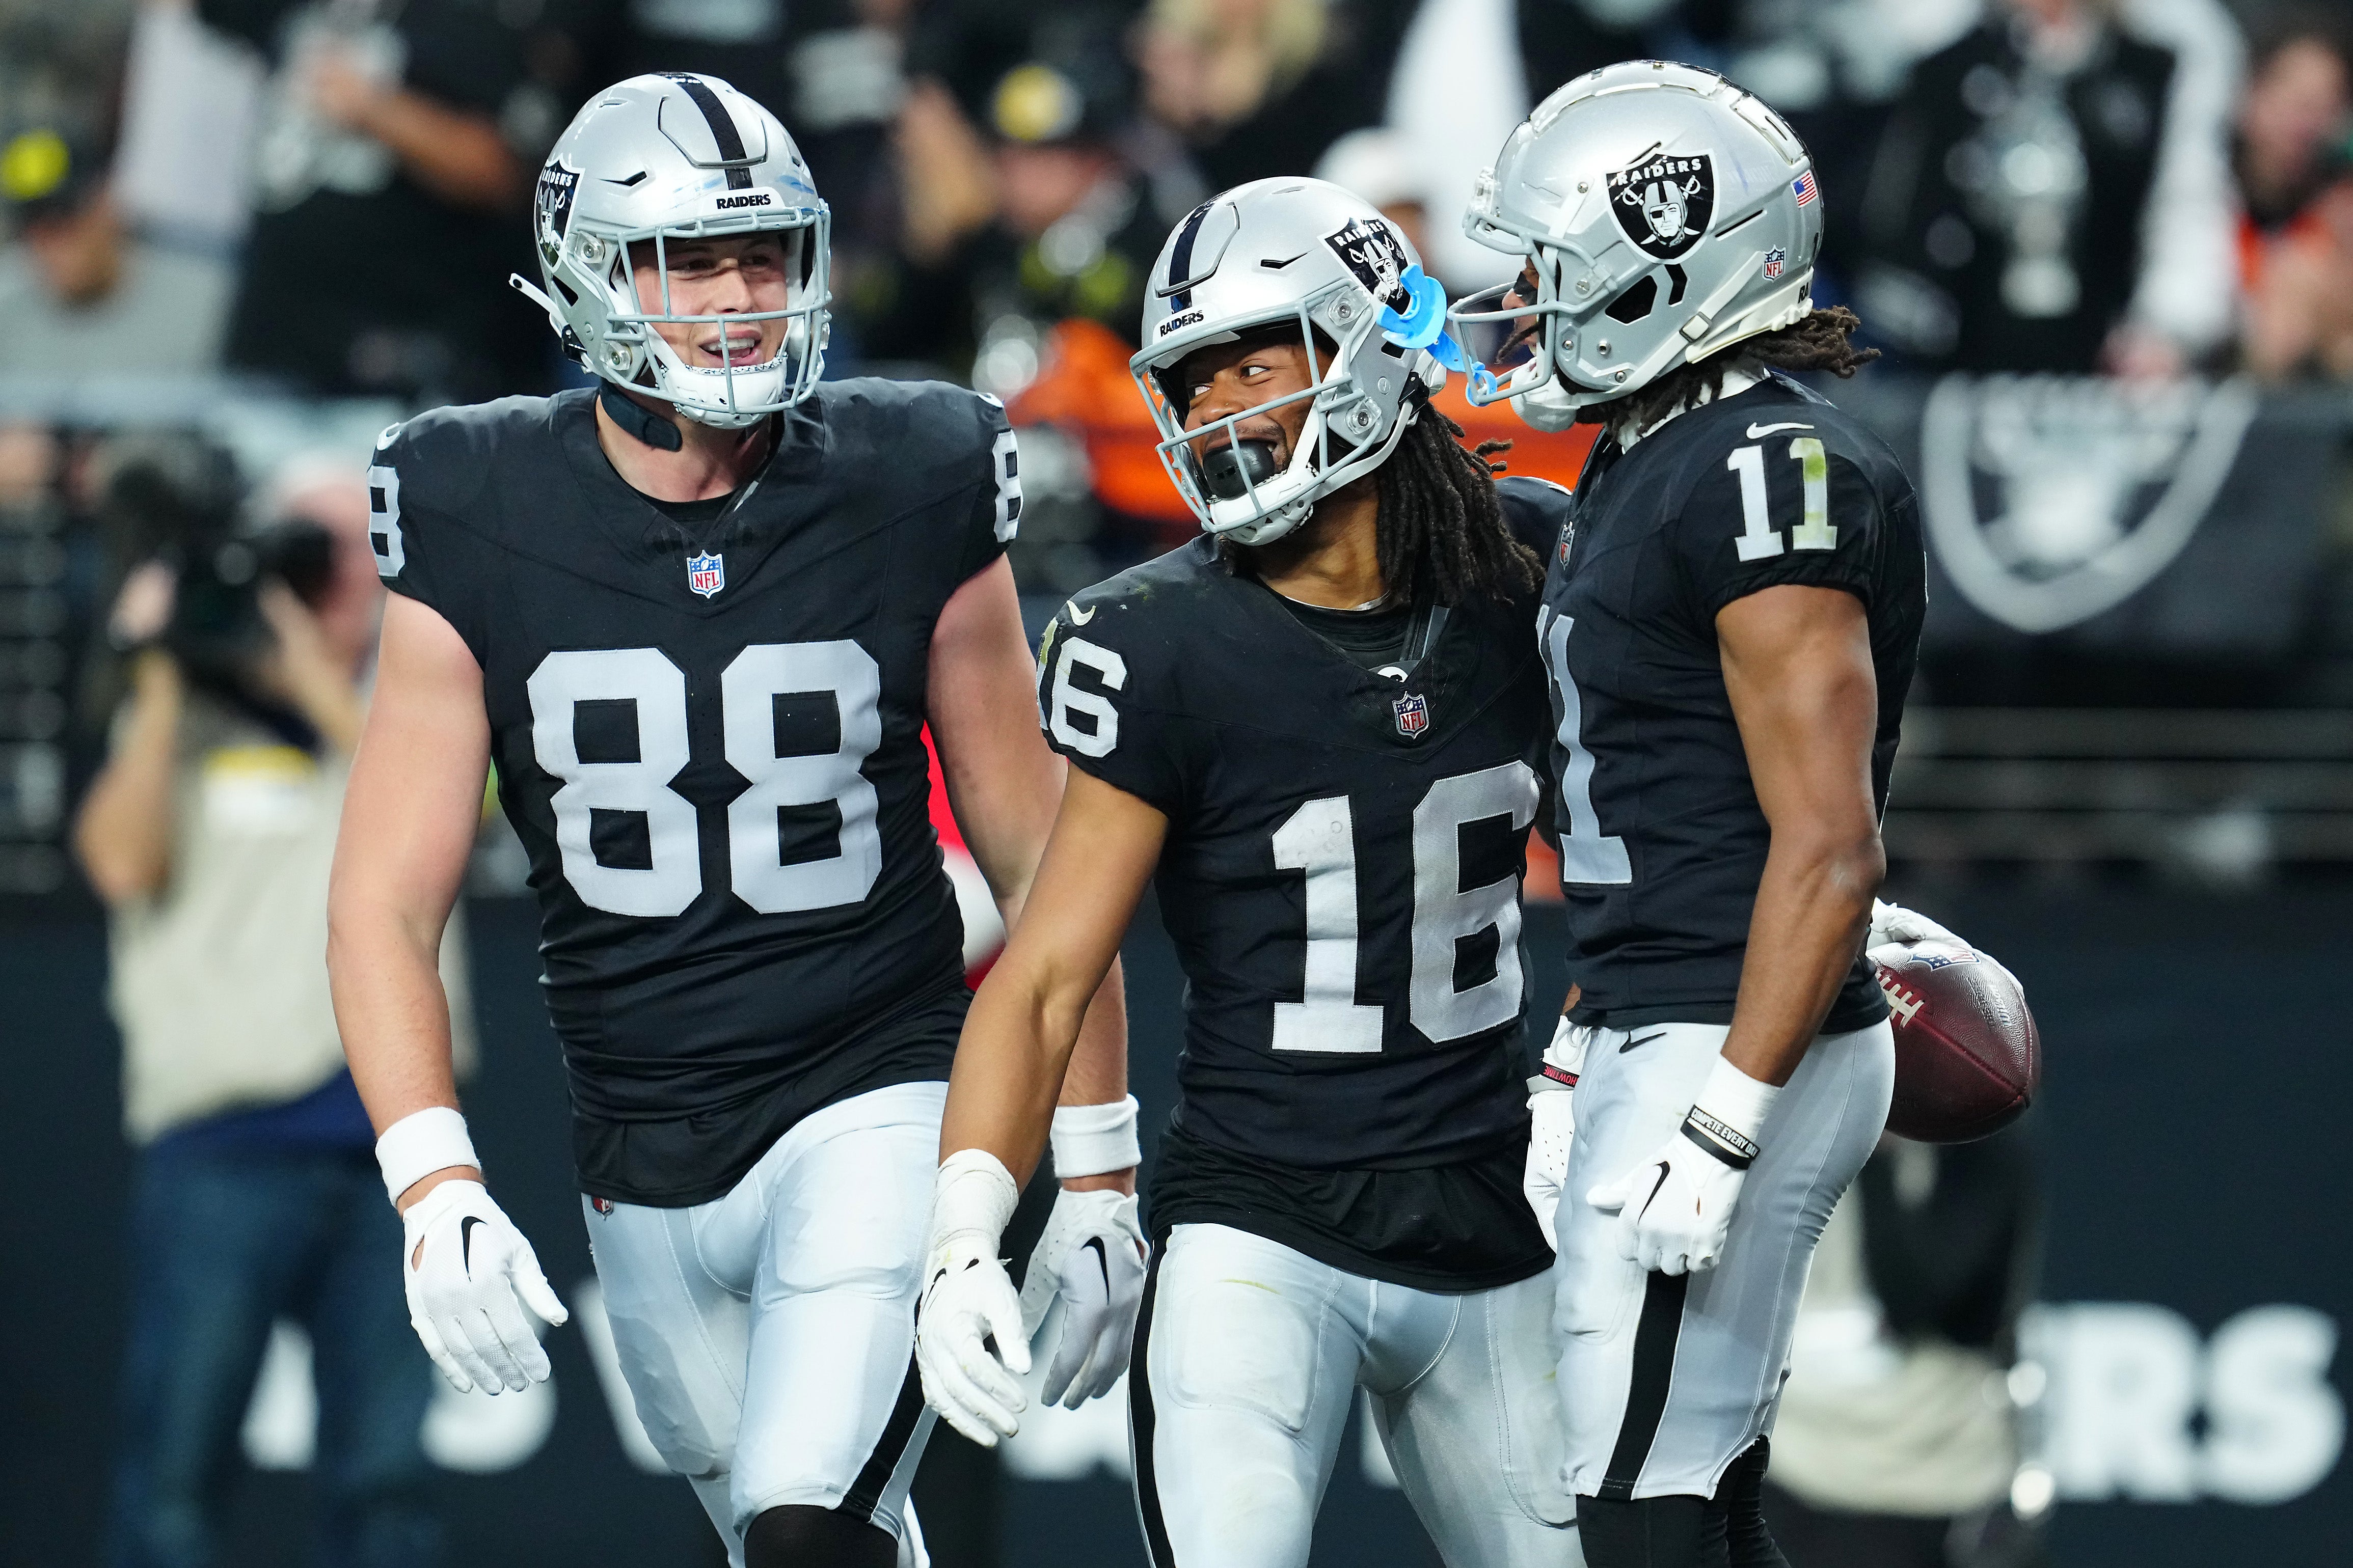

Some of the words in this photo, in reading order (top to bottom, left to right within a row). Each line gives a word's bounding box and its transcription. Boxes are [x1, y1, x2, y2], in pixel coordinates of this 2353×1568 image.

[1616, 158, 1701, 185] RAIDERS
[716, 194, 771, 209] RAIDERS
[1766, 262, 1782, 277] NFL
[1160, 310, 1204, 337] RAIDERS
[1727, 437, 1837, 562] 11
[694, 572, 719, 589] NFL
[1401, 712, 1424, 730] NFL
[526, 639, 882, 917] 88
[1272, 760, 1540, 1053] 16
[1543, 1065, 1578, 1085] HOWTIME
[1691, 1107, 1724, 1134] COMPETE
[1720, 1126, 1748, 1149] EVERY
[1745, 1143, 1759, 1157] DAY
